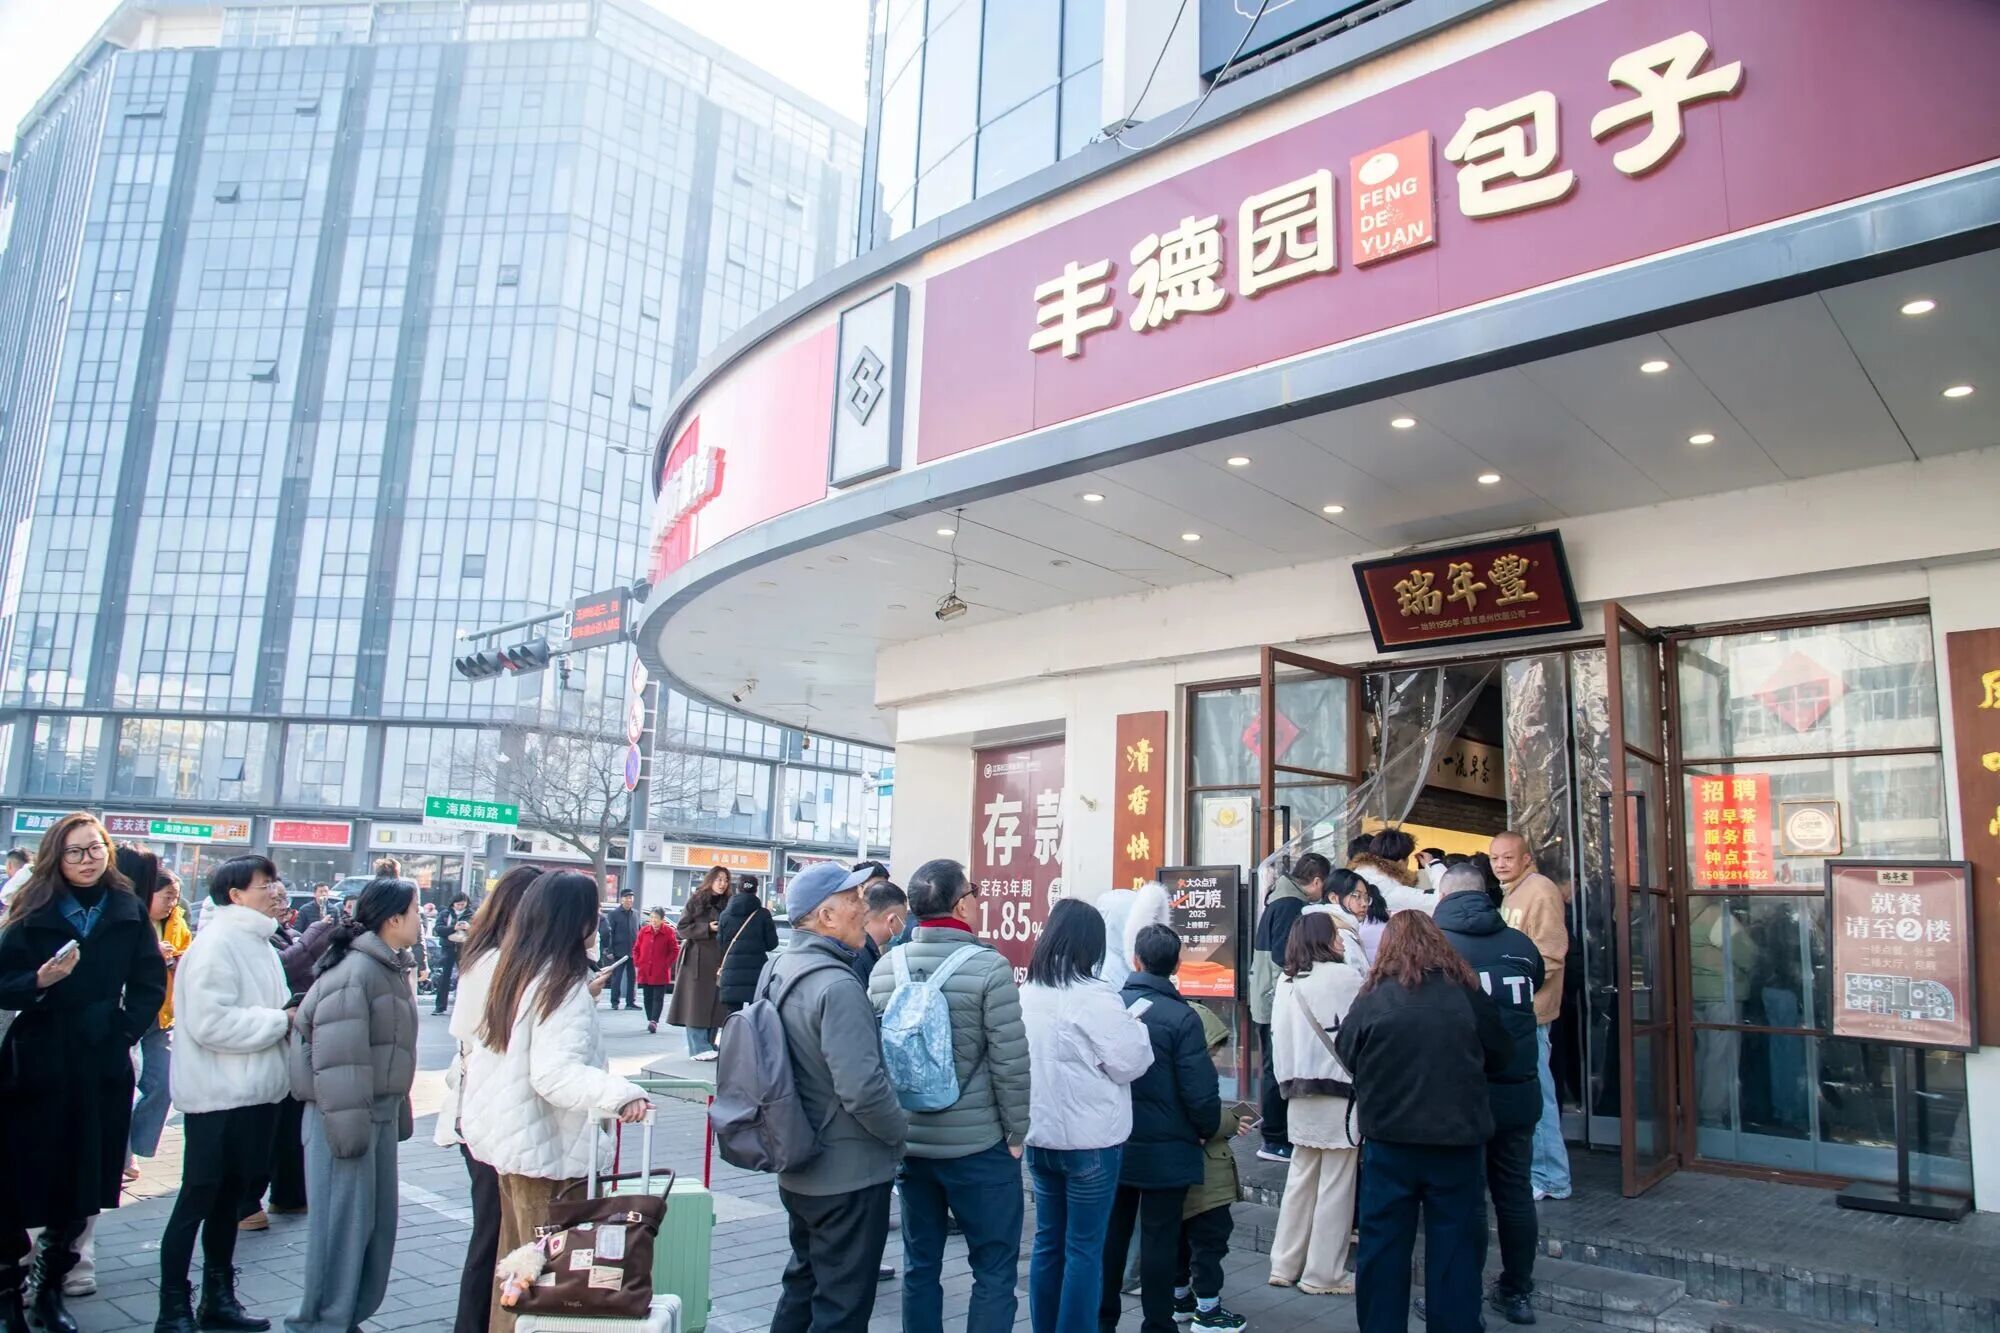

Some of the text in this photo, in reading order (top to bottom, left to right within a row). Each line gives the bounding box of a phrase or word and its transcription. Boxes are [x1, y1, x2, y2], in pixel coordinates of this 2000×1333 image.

[1028, 30, 1745, 359] 丰德园 包子
[1360, 178, 1417, 210] FENG
[1361, 210, 1387, 232] DE
[1361, 221, 1424, 254] YUAN
[1701, 778, 1757, 803] 招聘
[445, 801, 499, 820] 海陵南路
[1703, 808, 1757, 825] 招早茶
[982, 788, 1065, 866] 存款
[1703, 828, 1758, 845] 服务员
[1704, 849, 1759, 866] 钟点工
[980, 879, 1032, 898] 定存3年期
[1186, 877, 1217, 888] 大众点评
[1188, 910, 1207, 918] 2025
[1870, 892, 1921, 916] 就餐
[978, 901, 1044, 942] 1.85%
[1845, 916, 1952, 943] 请至2楼
